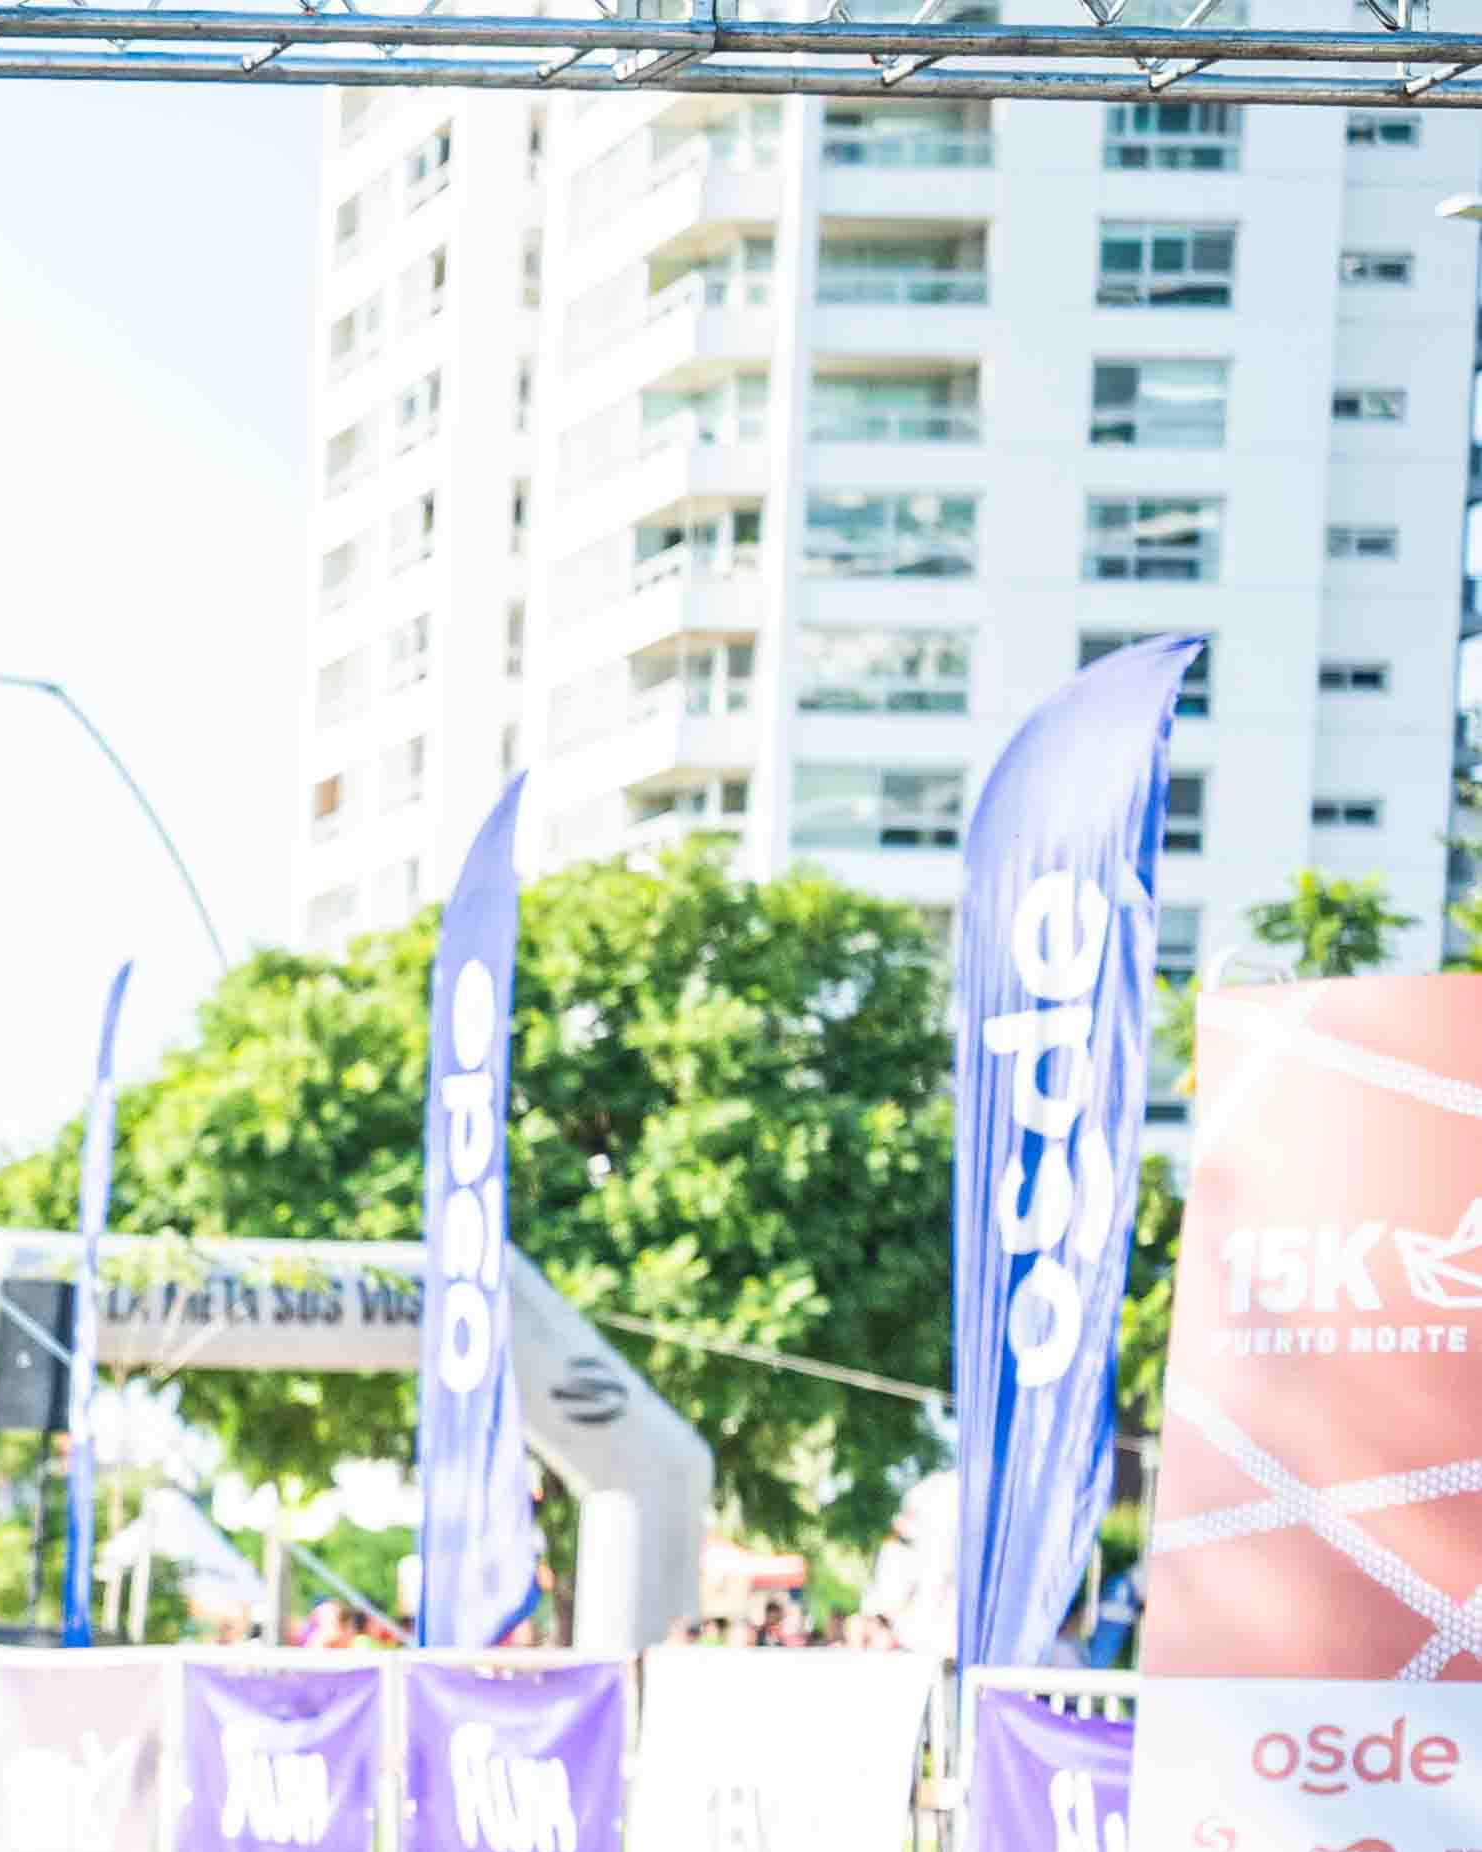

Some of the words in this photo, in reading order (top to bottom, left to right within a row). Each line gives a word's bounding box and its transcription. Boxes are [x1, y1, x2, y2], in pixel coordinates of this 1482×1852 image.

[983, 870, 1114, 1389] osde
[1219, 1221, 1387, 1312] 15K
[1348, 1324, 1468, 1353] NORTE
[1252, 1714, 1460, 1795] osde
